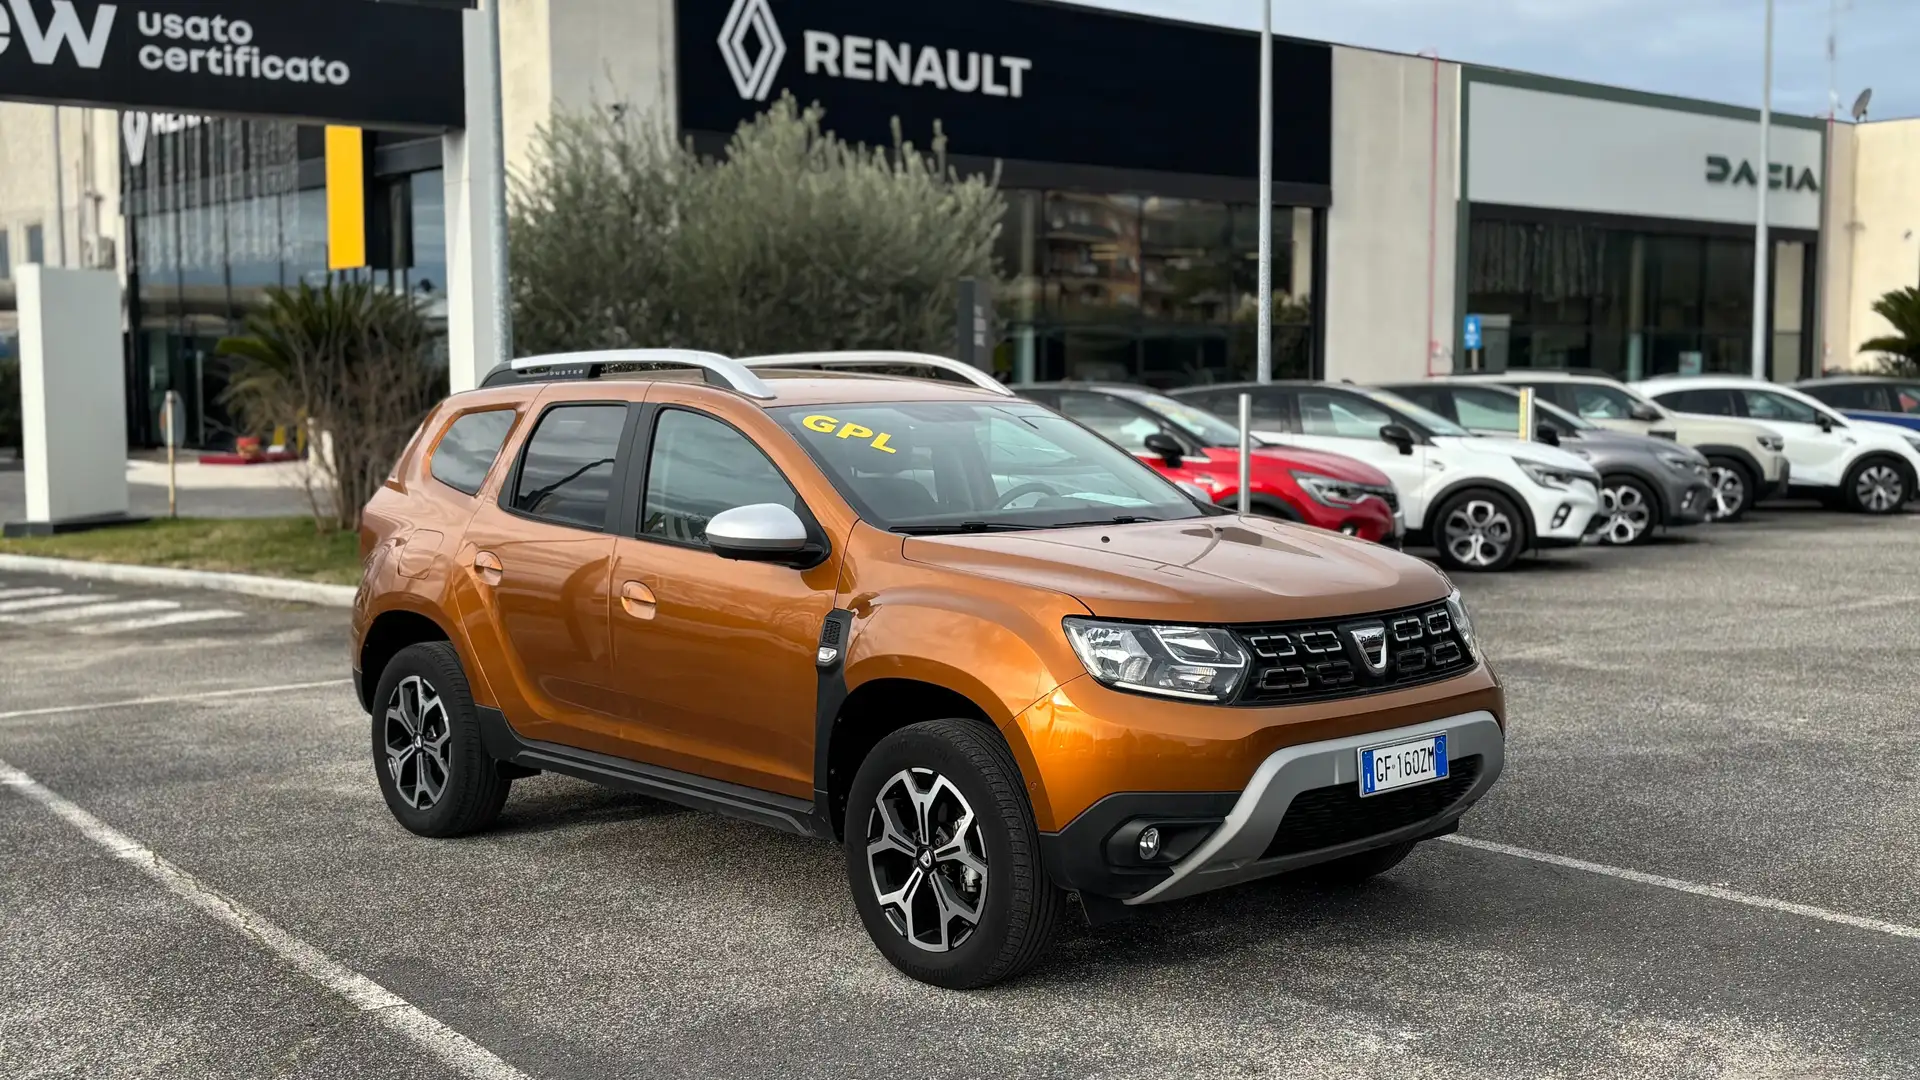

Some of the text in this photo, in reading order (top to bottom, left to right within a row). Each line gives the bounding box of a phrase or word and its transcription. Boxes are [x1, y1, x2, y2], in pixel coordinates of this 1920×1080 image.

[0, 0, 117, 69] w
[137, 11, 253, 45] usato
[138, 44, 350, 85] certificato
[804, 30, 1032, 97] RENAULT
[1706, 155, 1818, 192] DACIA
[802, 415, 897, 454] GPL
